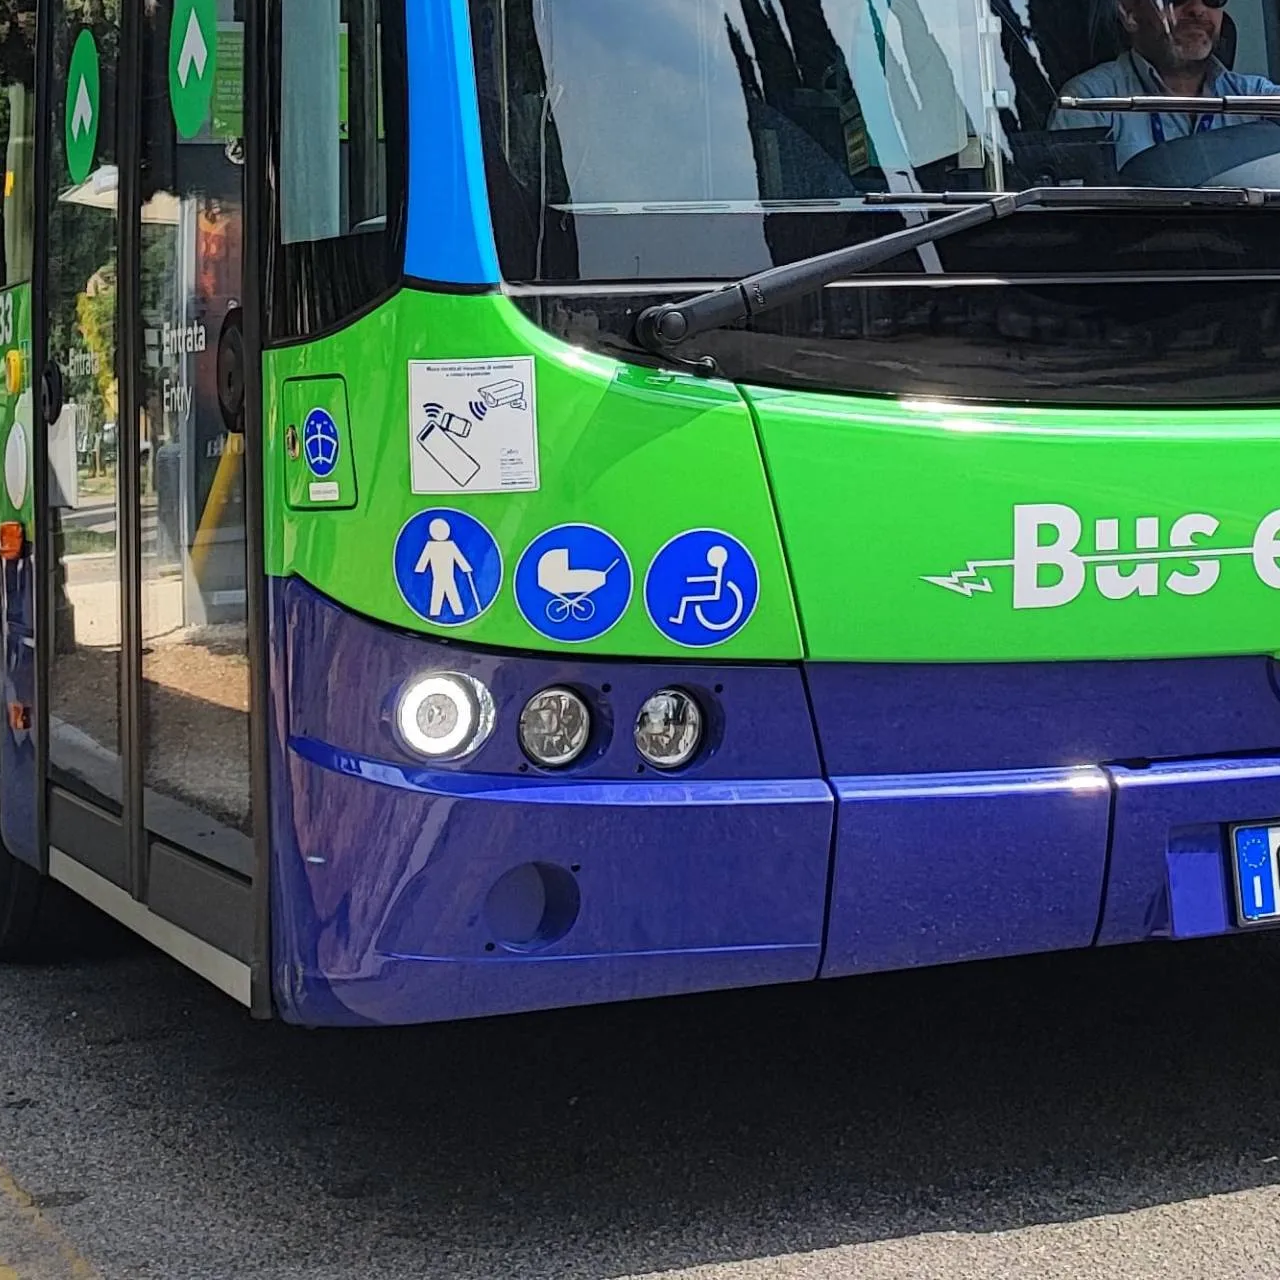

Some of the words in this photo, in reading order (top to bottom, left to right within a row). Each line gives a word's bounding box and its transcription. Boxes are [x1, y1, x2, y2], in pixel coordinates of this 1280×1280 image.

[163, 319, 206, 356] Entrata
[69, 347, 100, 377] Entrata
[163, 378, 193, 422] Entry
[1012, 503, 1221, 609] Bus
